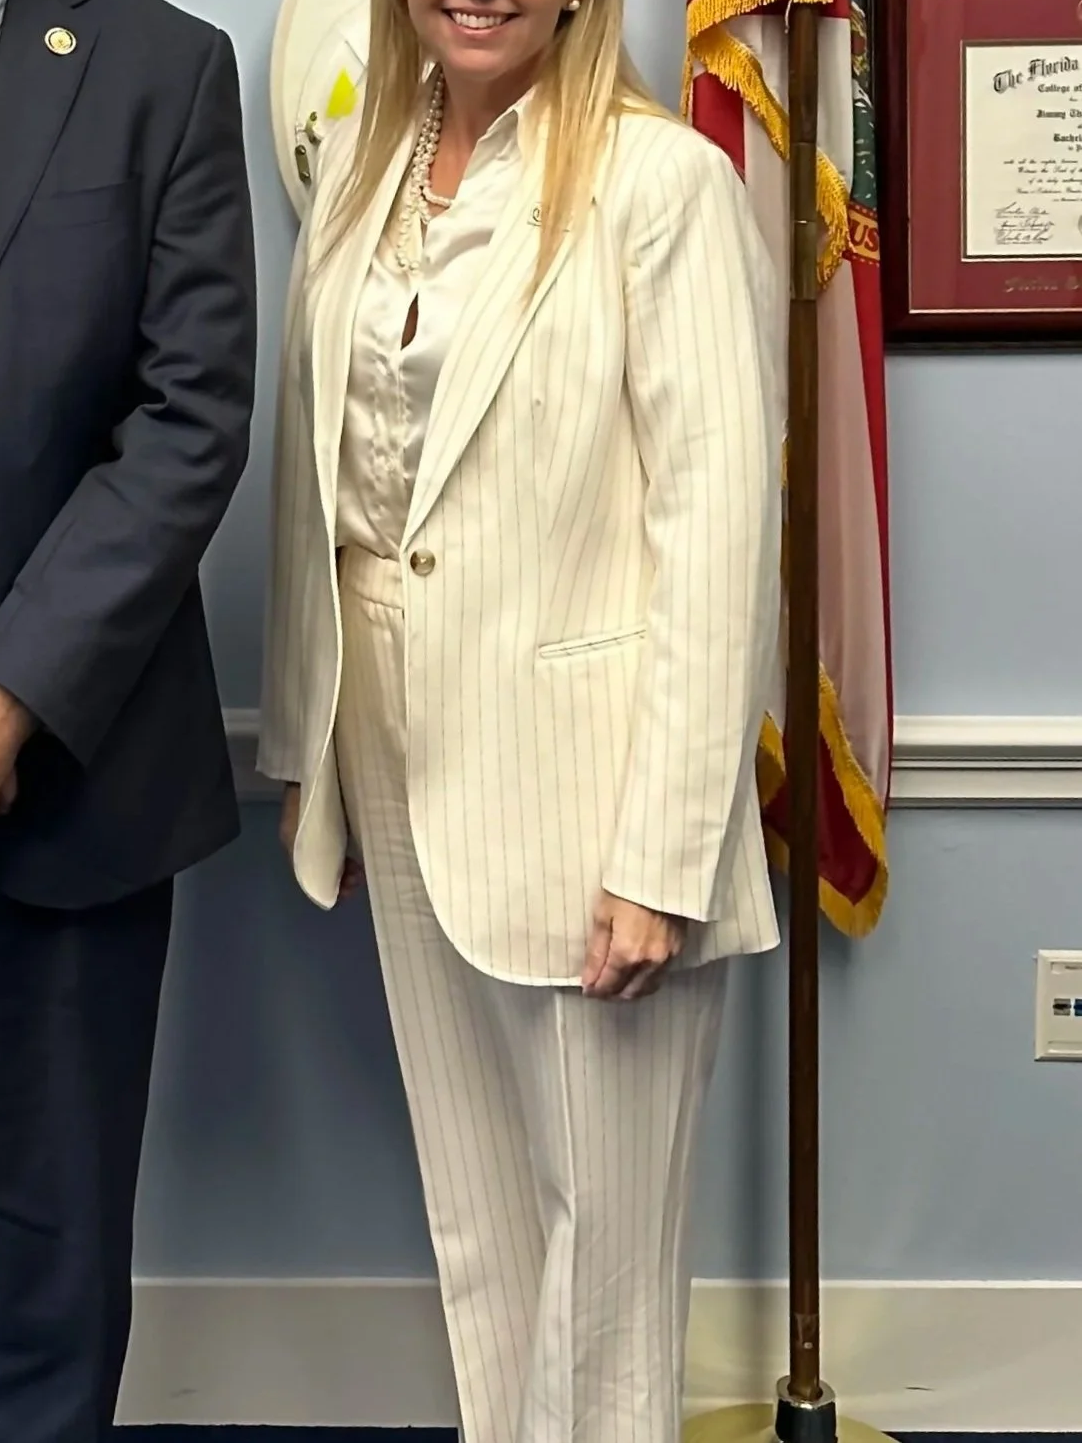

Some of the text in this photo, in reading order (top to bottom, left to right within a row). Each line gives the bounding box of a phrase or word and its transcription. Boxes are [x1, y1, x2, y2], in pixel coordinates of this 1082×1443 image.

[993, 56, 1080, 94] The Florida
[1037, 83, 1070, 94] College
